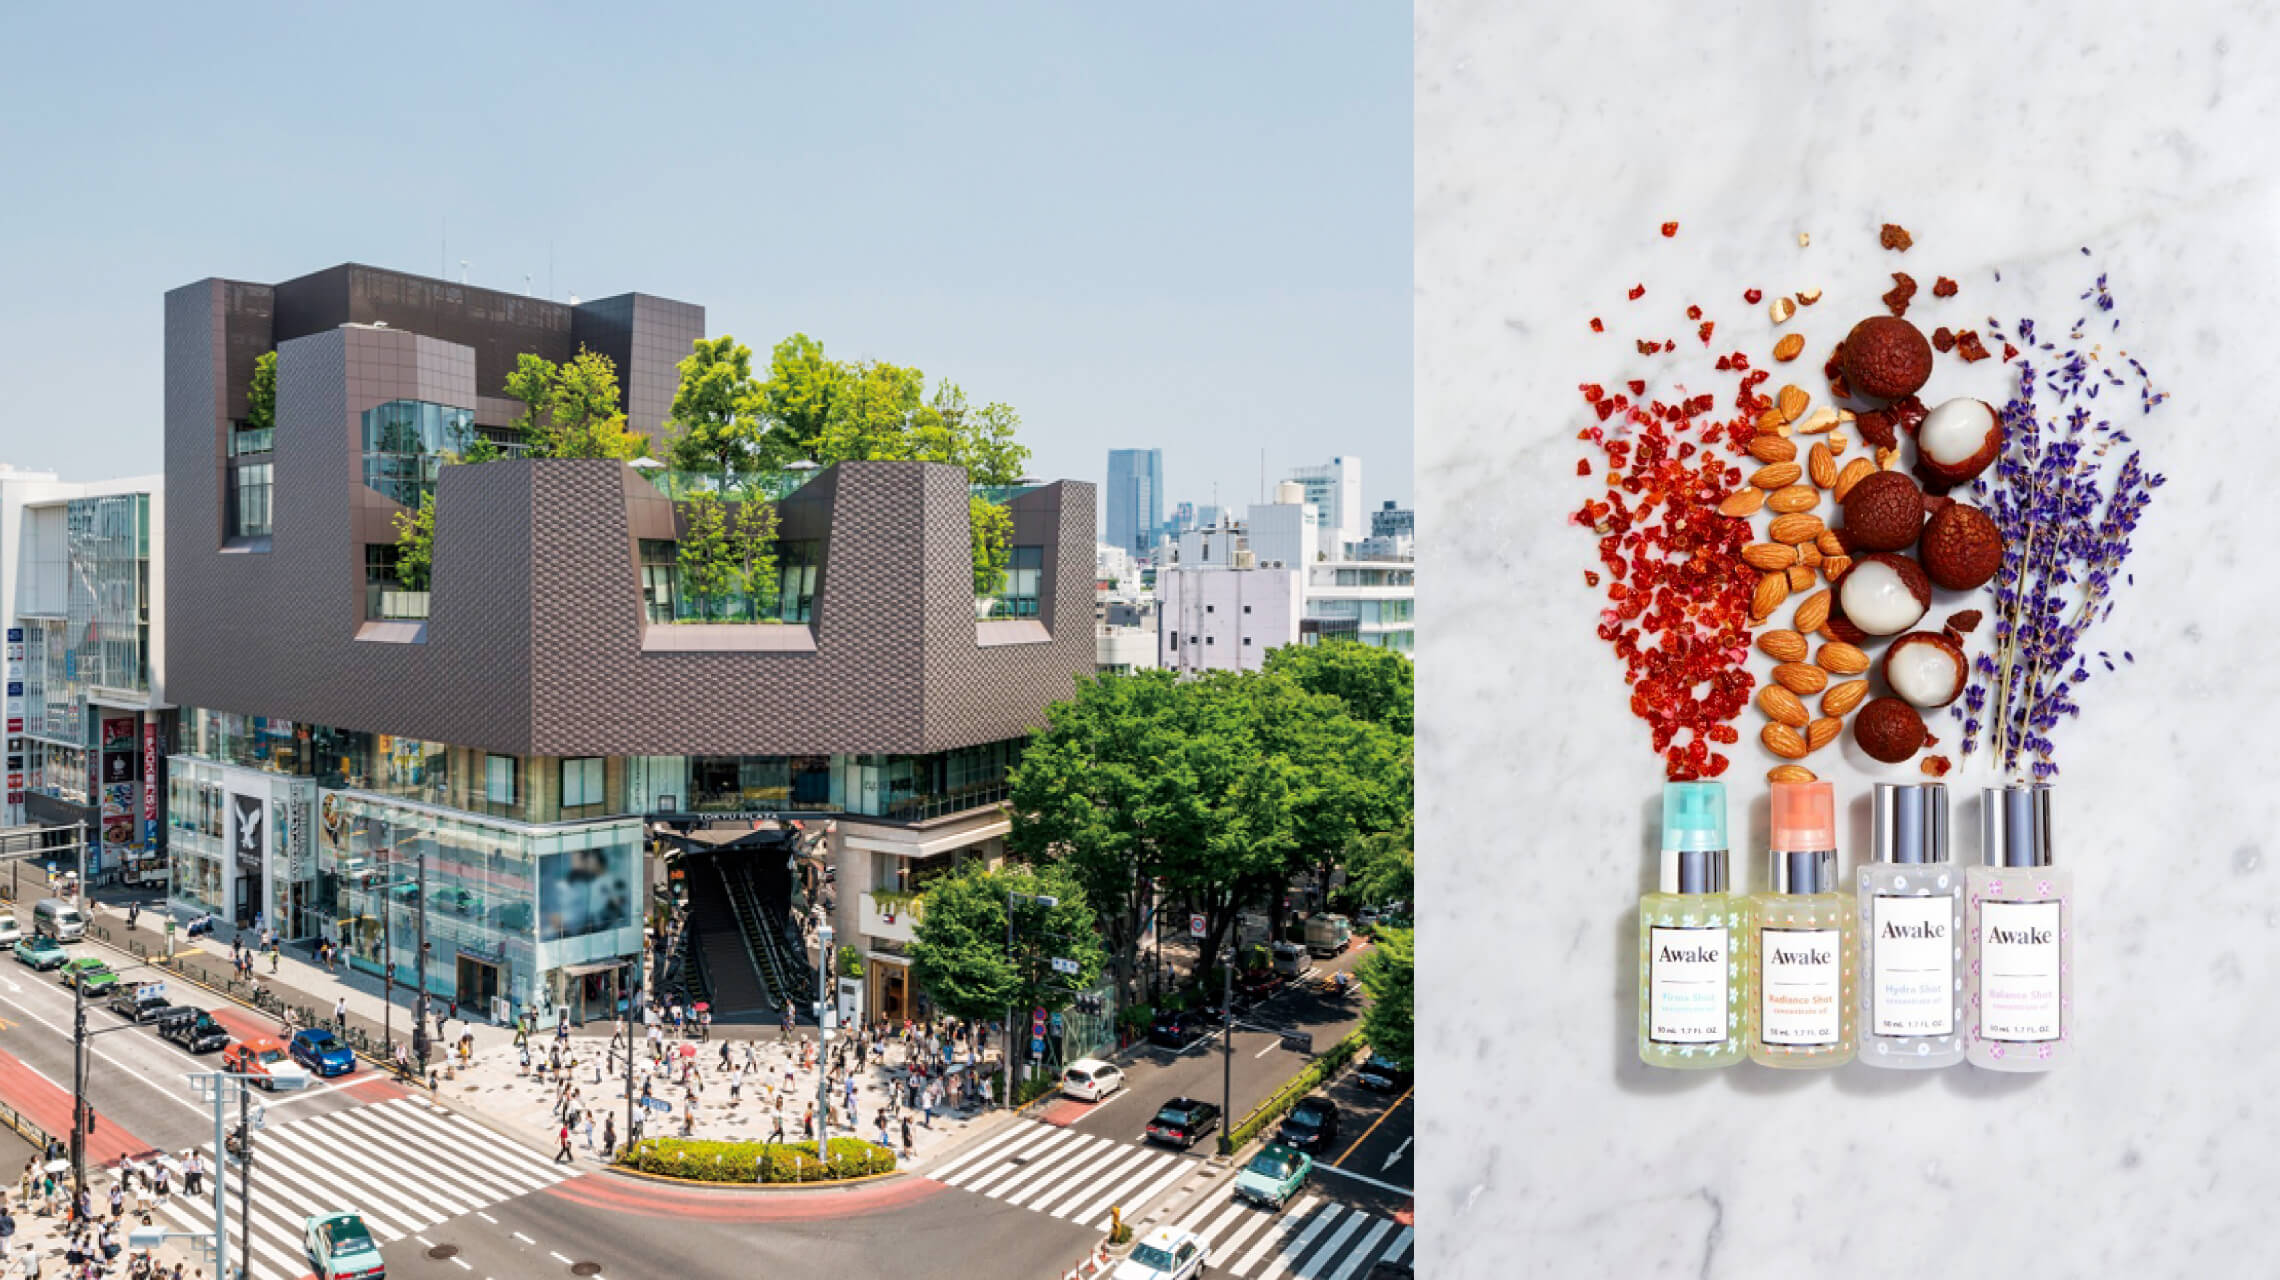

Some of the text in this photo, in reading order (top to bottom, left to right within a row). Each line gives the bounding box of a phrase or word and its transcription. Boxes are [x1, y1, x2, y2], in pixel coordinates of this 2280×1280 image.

[1882, 920, 1945, 939] Awake
[1988, 926, 2052, 944] Awake
[1659, 945, 1719, 963] Awake
[1771, 948, 1832, 965] Awake
[1919, 984, 1942, 993] Shot
[2030, 990, 2052, 1000] Shot
[1768, 994, 1832, 1005] Radiance Shot
